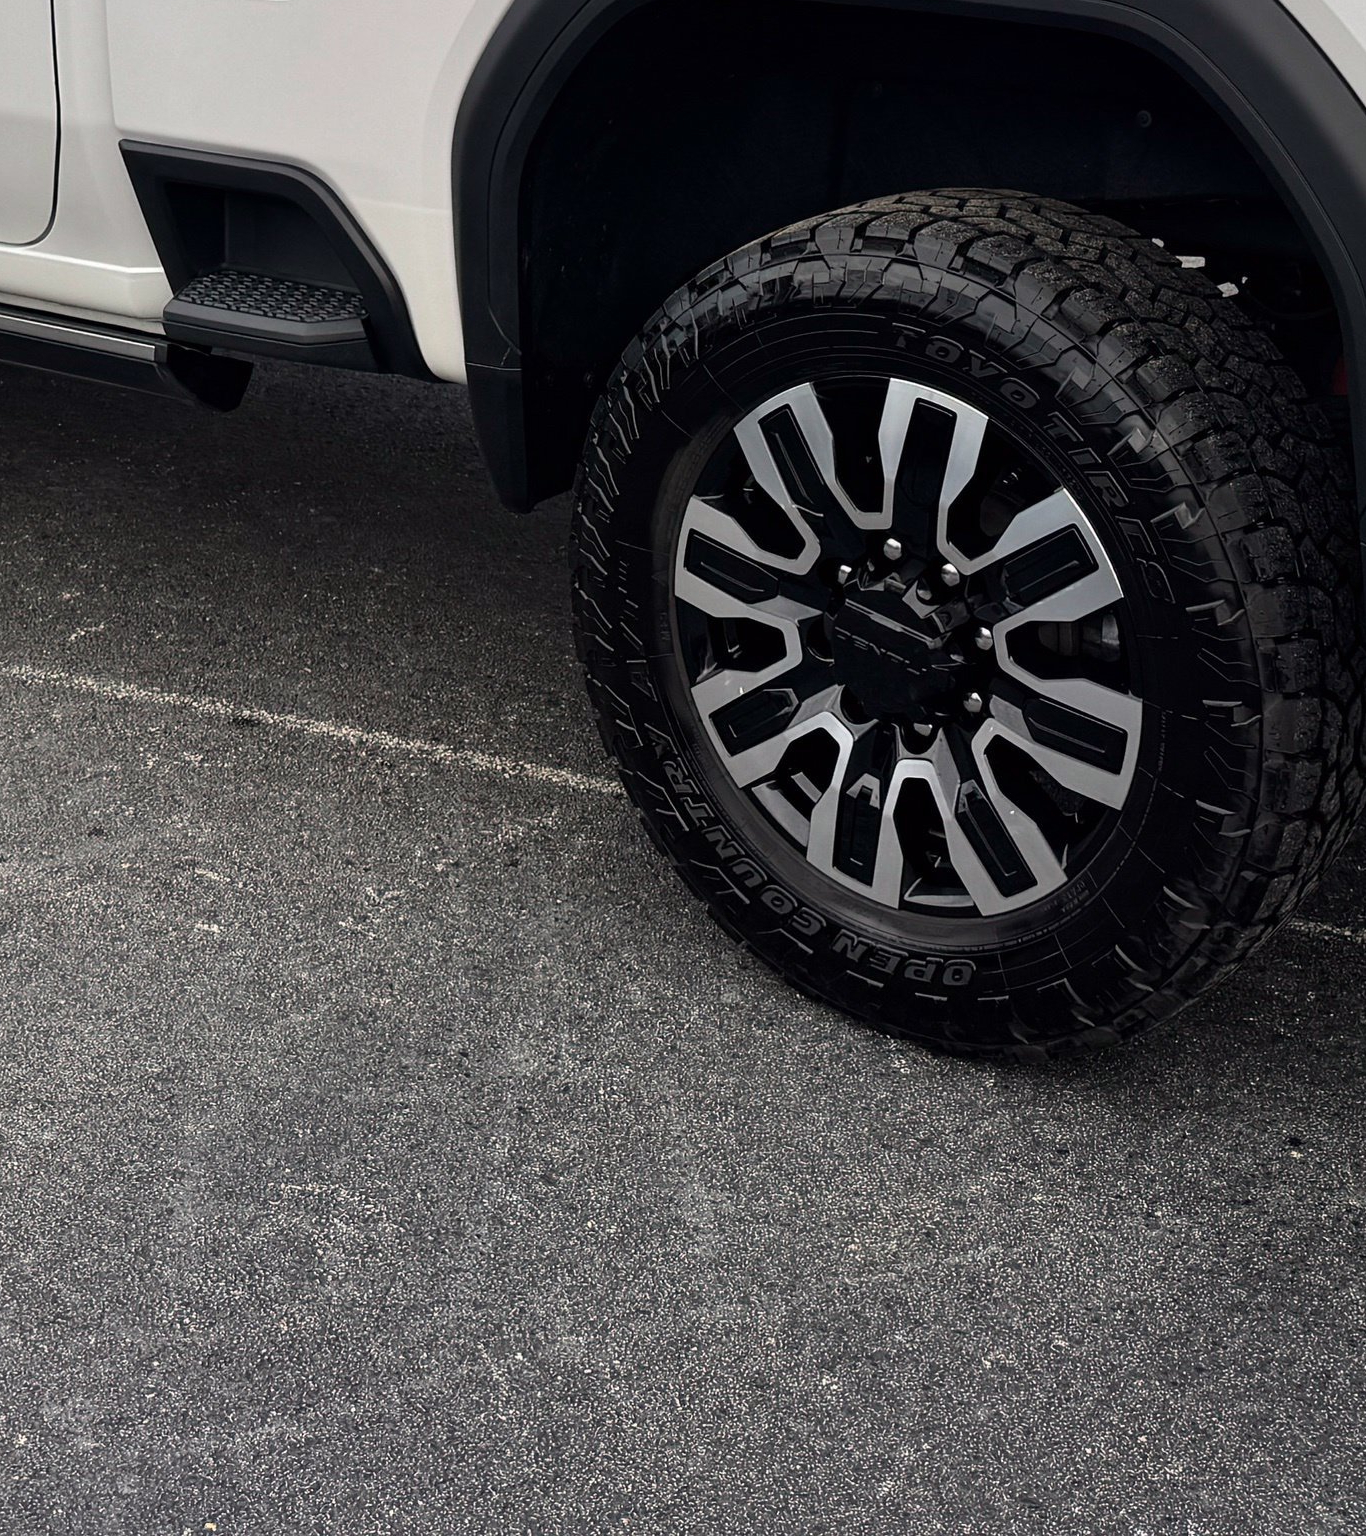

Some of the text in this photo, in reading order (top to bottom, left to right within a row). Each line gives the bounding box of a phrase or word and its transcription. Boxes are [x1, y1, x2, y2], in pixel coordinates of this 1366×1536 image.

[890, 321, 1177, 605] TOYO TIRES
[643, 722, 978, 988] OPEN COUNTRY
